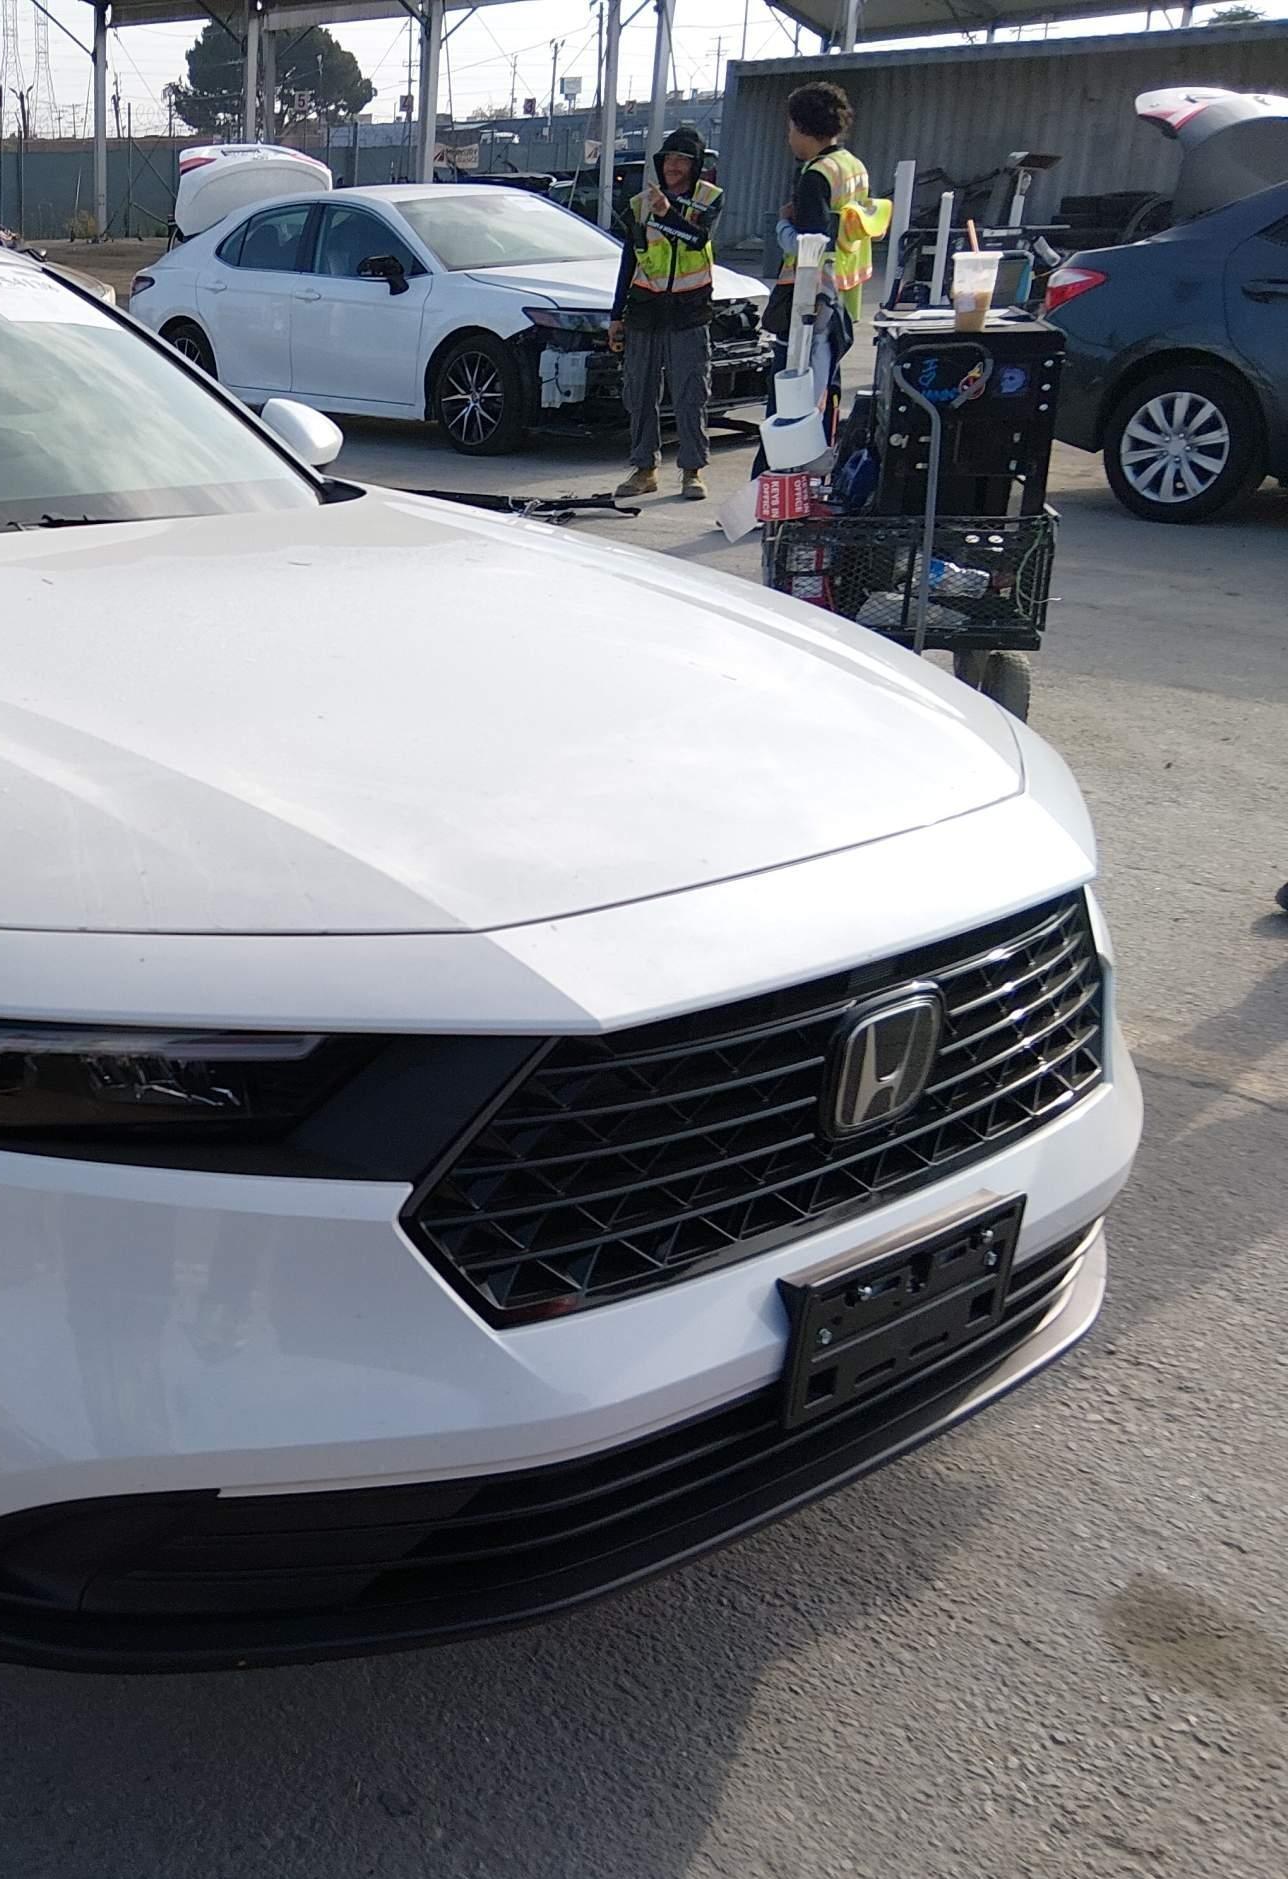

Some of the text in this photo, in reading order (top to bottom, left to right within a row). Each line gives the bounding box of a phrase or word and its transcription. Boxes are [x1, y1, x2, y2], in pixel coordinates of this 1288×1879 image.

[298, 94, 306, 108] 5
[626, 101, 634, 115] 2
[762, 483, 770, 516] OFFICE
[771, 481, 780, 518] KEYS IN
